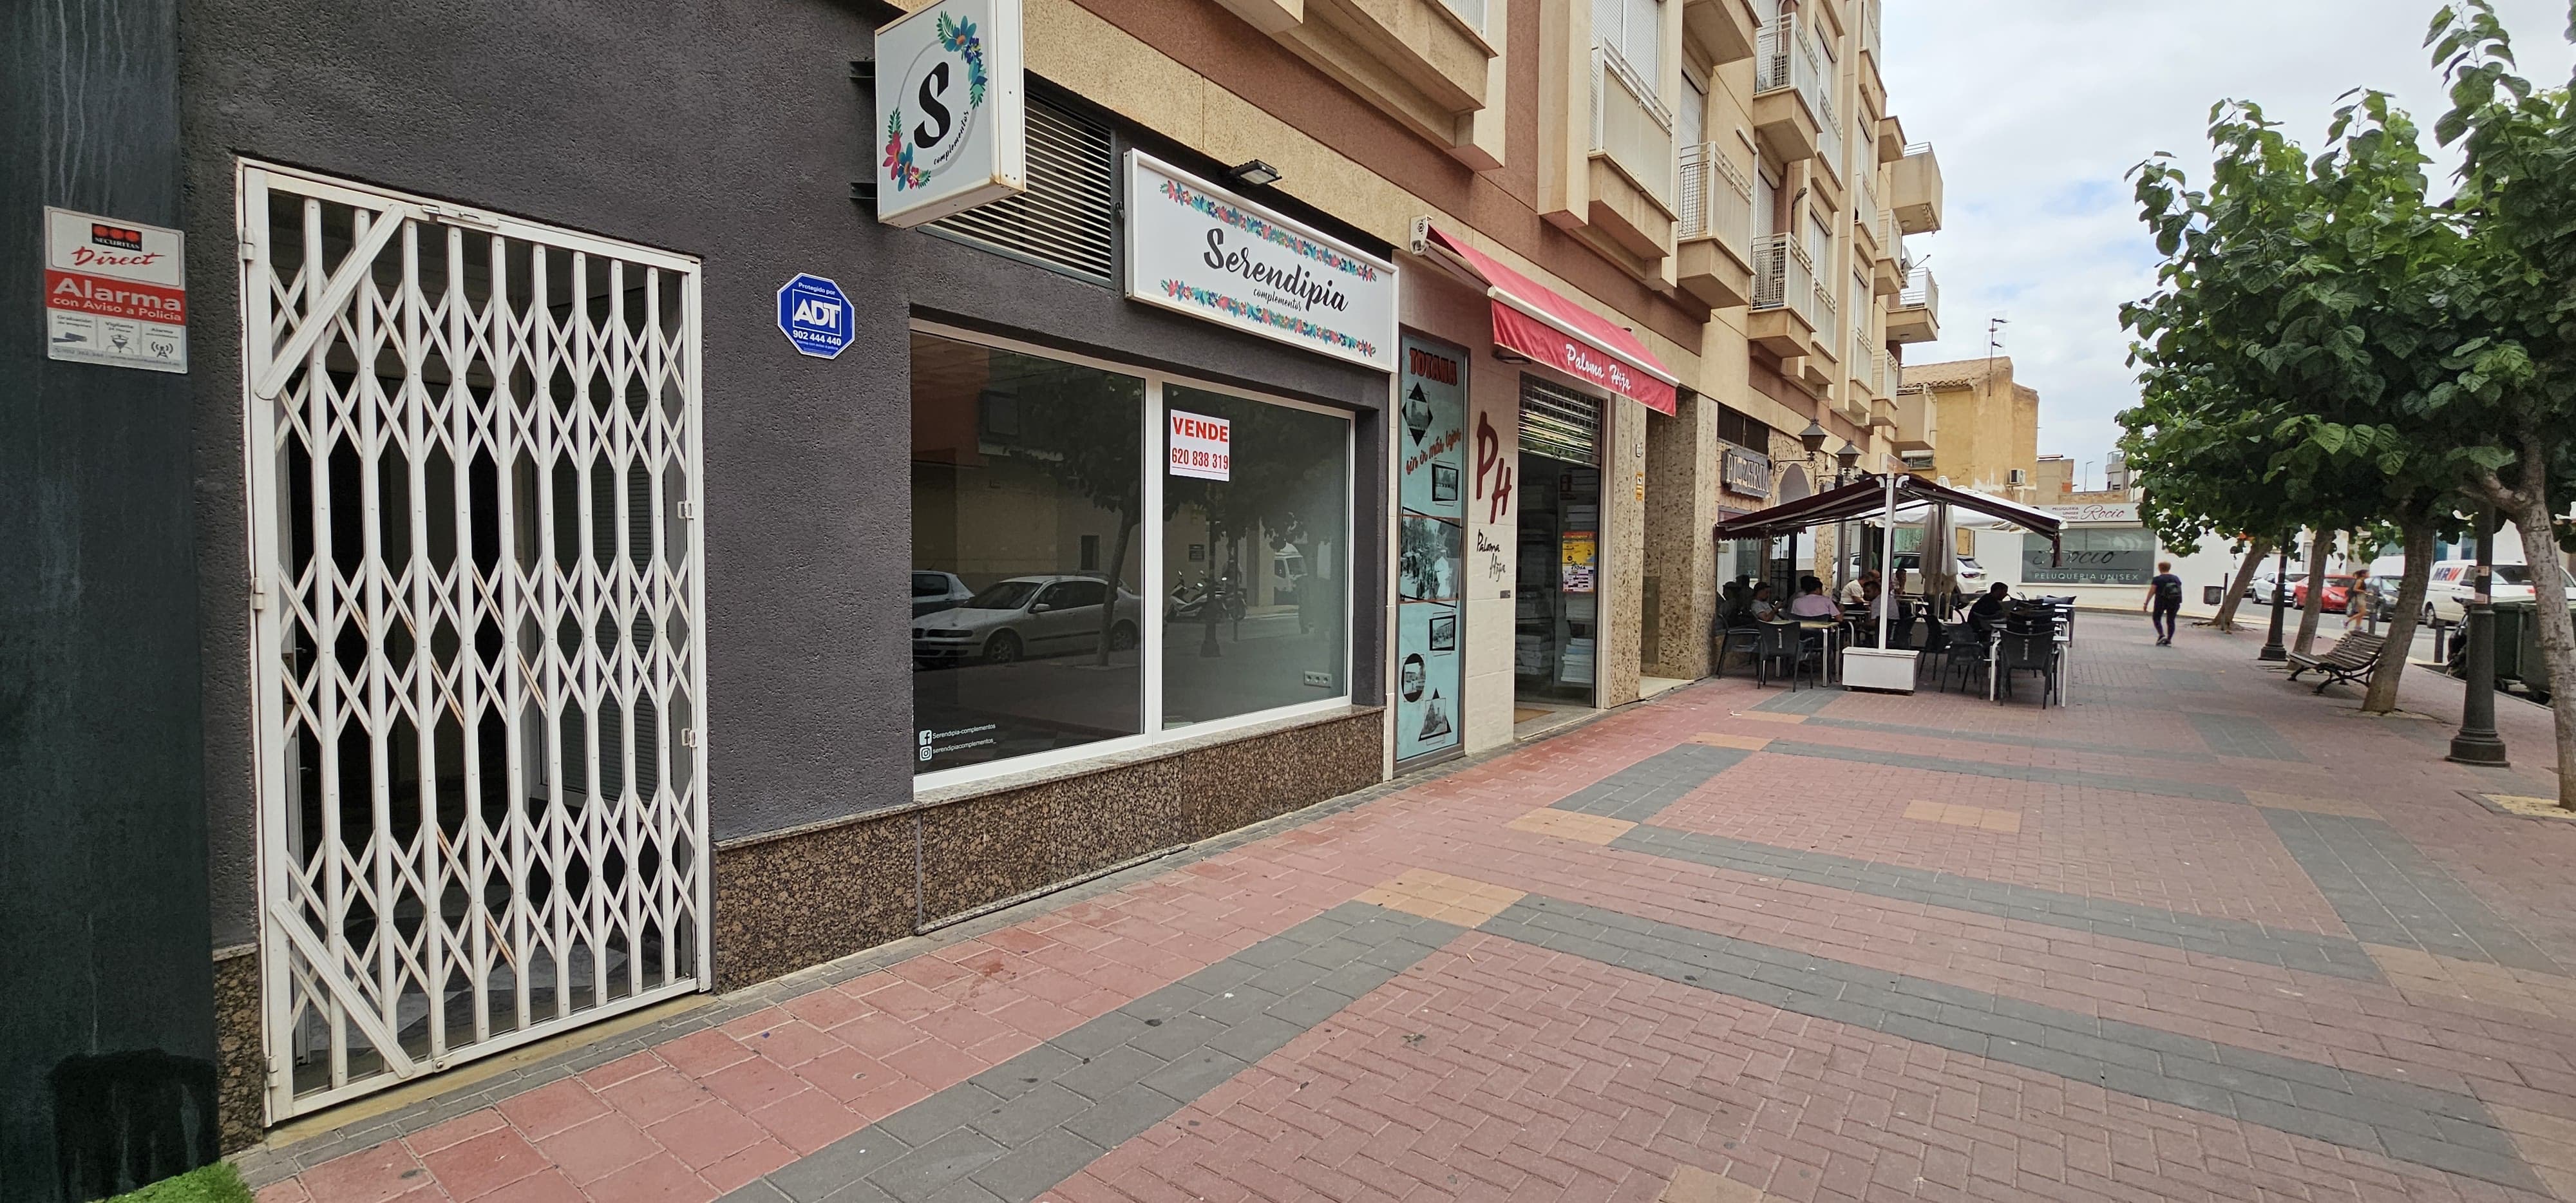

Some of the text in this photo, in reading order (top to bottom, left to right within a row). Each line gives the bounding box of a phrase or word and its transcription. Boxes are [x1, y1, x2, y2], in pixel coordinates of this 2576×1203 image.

[914, 61, 951, 149] S
[933, 110, 969, 165] complementos
[71, 246, 165, 265] Direct
[94, 237, 140, 249] SECURITAS
[1204, 228, 1349, 312] Serendipia
[53, 278, 181, 311] Alarma
[799, 282, 825, 293] Protegido
[1253, 287, 1302, 312] complementos
[53, 298, 79, 307] con
[83, 300, 122, 312] Aviso
[139, 307, 181, 321] Policía
[794, 298, 840, 328] ADT
[793, 330, 808, 340] 902
[810, 333, 825, 343] 444
[827, 336, 842, 346] 440
[1409, 347, 1457, 386] TOTANA
[1566, 344, 1631, 392] Paloma Hija
[1173, 417, 1228, 442] VENDE
[1172, 448, 1228, 469] 620 838 319
[1727, 453, 1769, 493] PIZZERIA
[1477, 529, 1501, 552] Paloma
[1489, 553, 1506, 582] Hija
[2432, 567, 2463, 581] MRW
[933, 723, 996, 739] Serendipia-complementos
